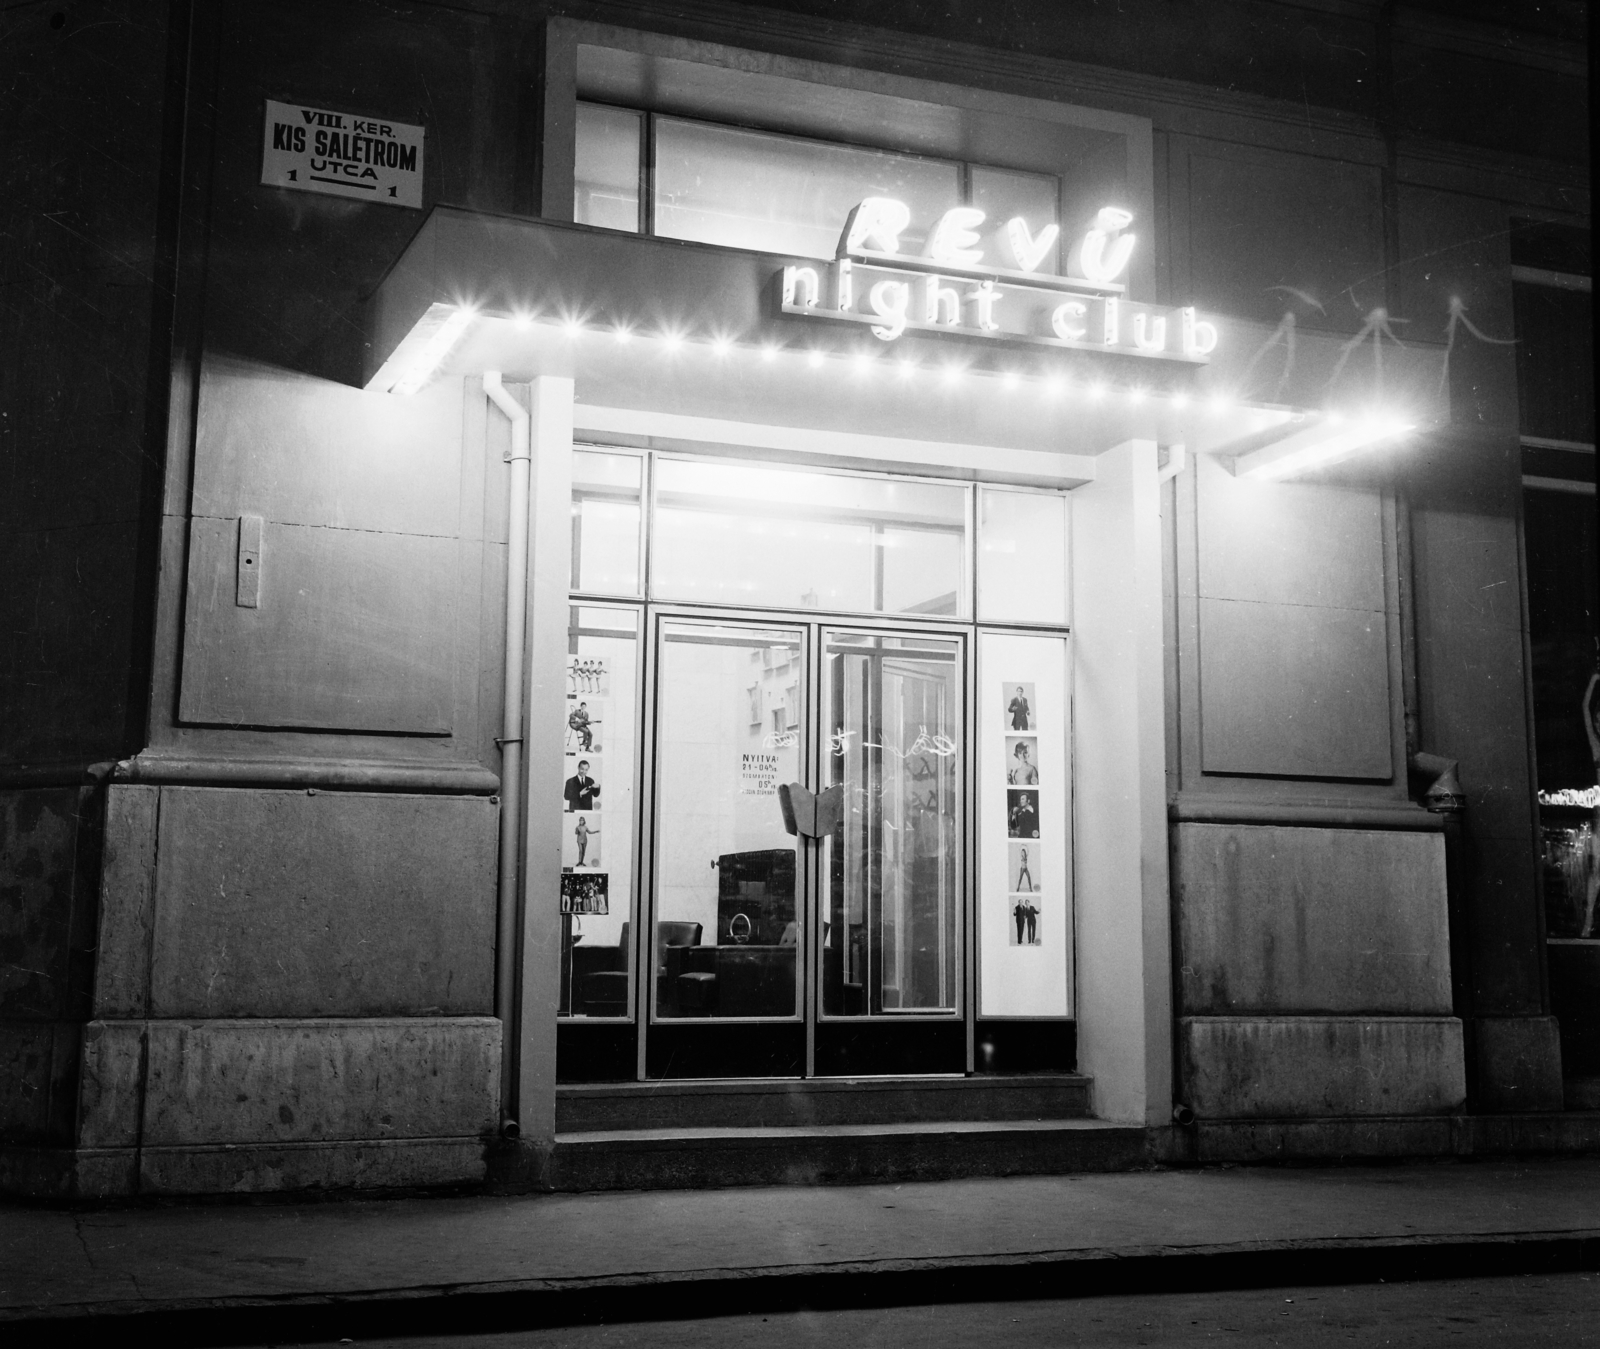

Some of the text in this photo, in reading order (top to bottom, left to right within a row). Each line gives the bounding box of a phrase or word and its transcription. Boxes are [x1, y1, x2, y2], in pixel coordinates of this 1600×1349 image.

[301, 110, 396, 138] VIII. KER.
[273, 122, 417, 172] KIS SALÉTROM
[287, 169, 398, 198] 1 1
[310, 158, 379, 180] UTCA
[781, 258, 1219, 356] night club
